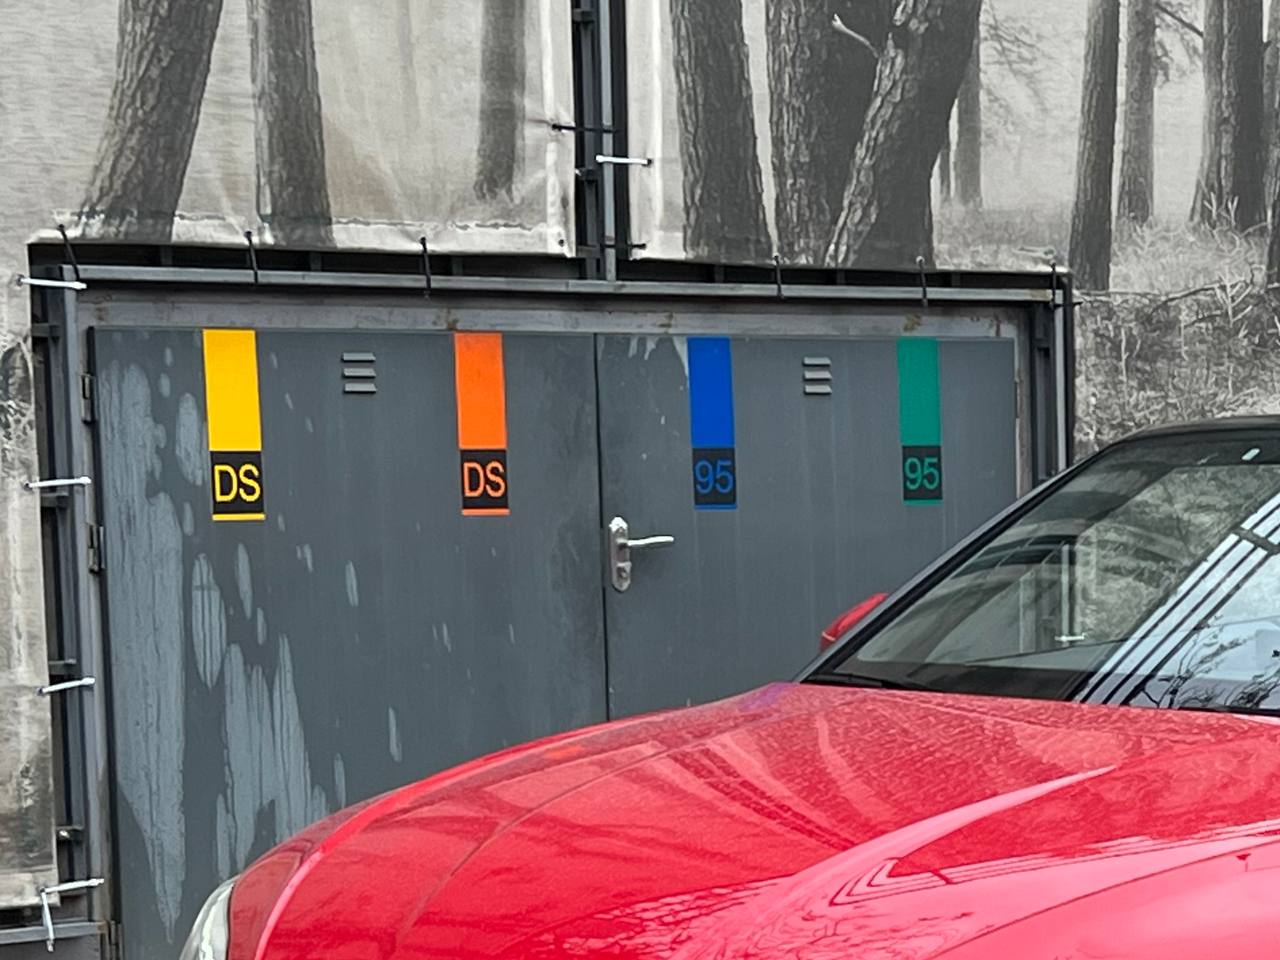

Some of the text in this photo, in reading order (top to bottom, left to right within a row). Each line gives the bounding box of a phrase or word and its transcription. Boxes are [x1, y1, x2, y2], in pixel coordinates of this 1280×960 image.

[213, 463, 261, 502] DS
[463, 461, 506, 498] DS
[694, 460, 735, 494] 95
[904, 457, 940, 490] 95
